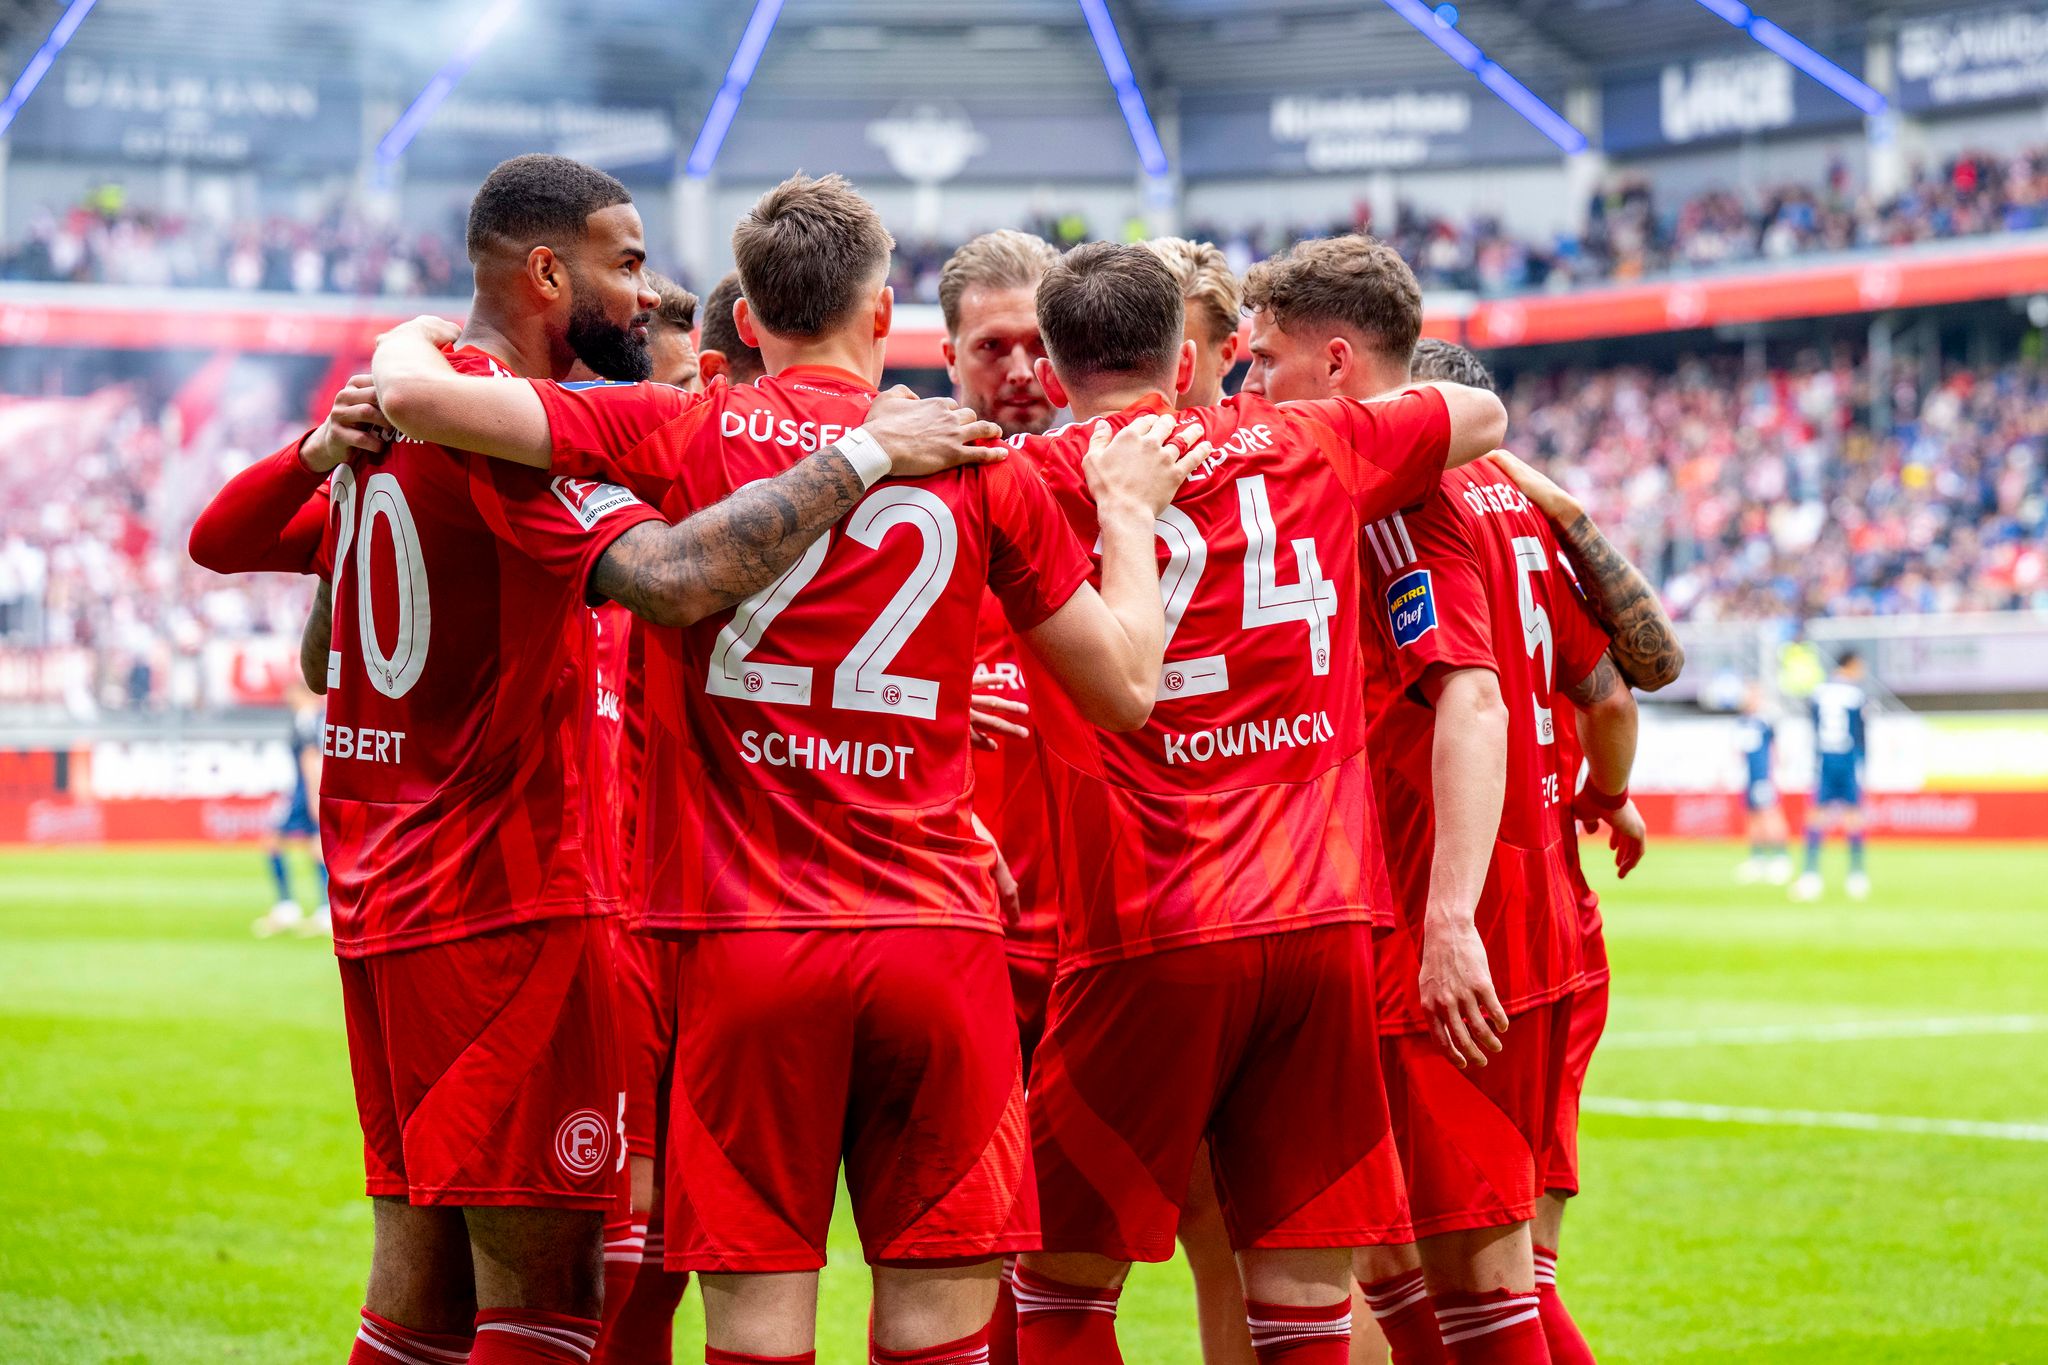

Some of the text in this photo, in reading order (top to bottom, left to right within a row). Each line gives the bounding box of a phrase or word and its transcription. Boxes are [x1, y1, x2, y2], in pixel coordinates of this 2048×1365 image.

[720, 408, 854, 452] DÜSSE
[584, 496, 634, 523] BUNDESLIGA
[704, 477, 958, 720] 22
[1092, 473, 1338, 703] 24
[1390, 585, 1427, 614] METRO
[1396, 602, 1425, 632] Chef
[1511, 536, 1554, 745] 5
[324, 723, 406, 764] EBERT
[739, 730, 914, 780] SCHMIDT
[1163, 710, 1335, 765] KOWNACKI
[584, 1148, 598, 1160] 95
